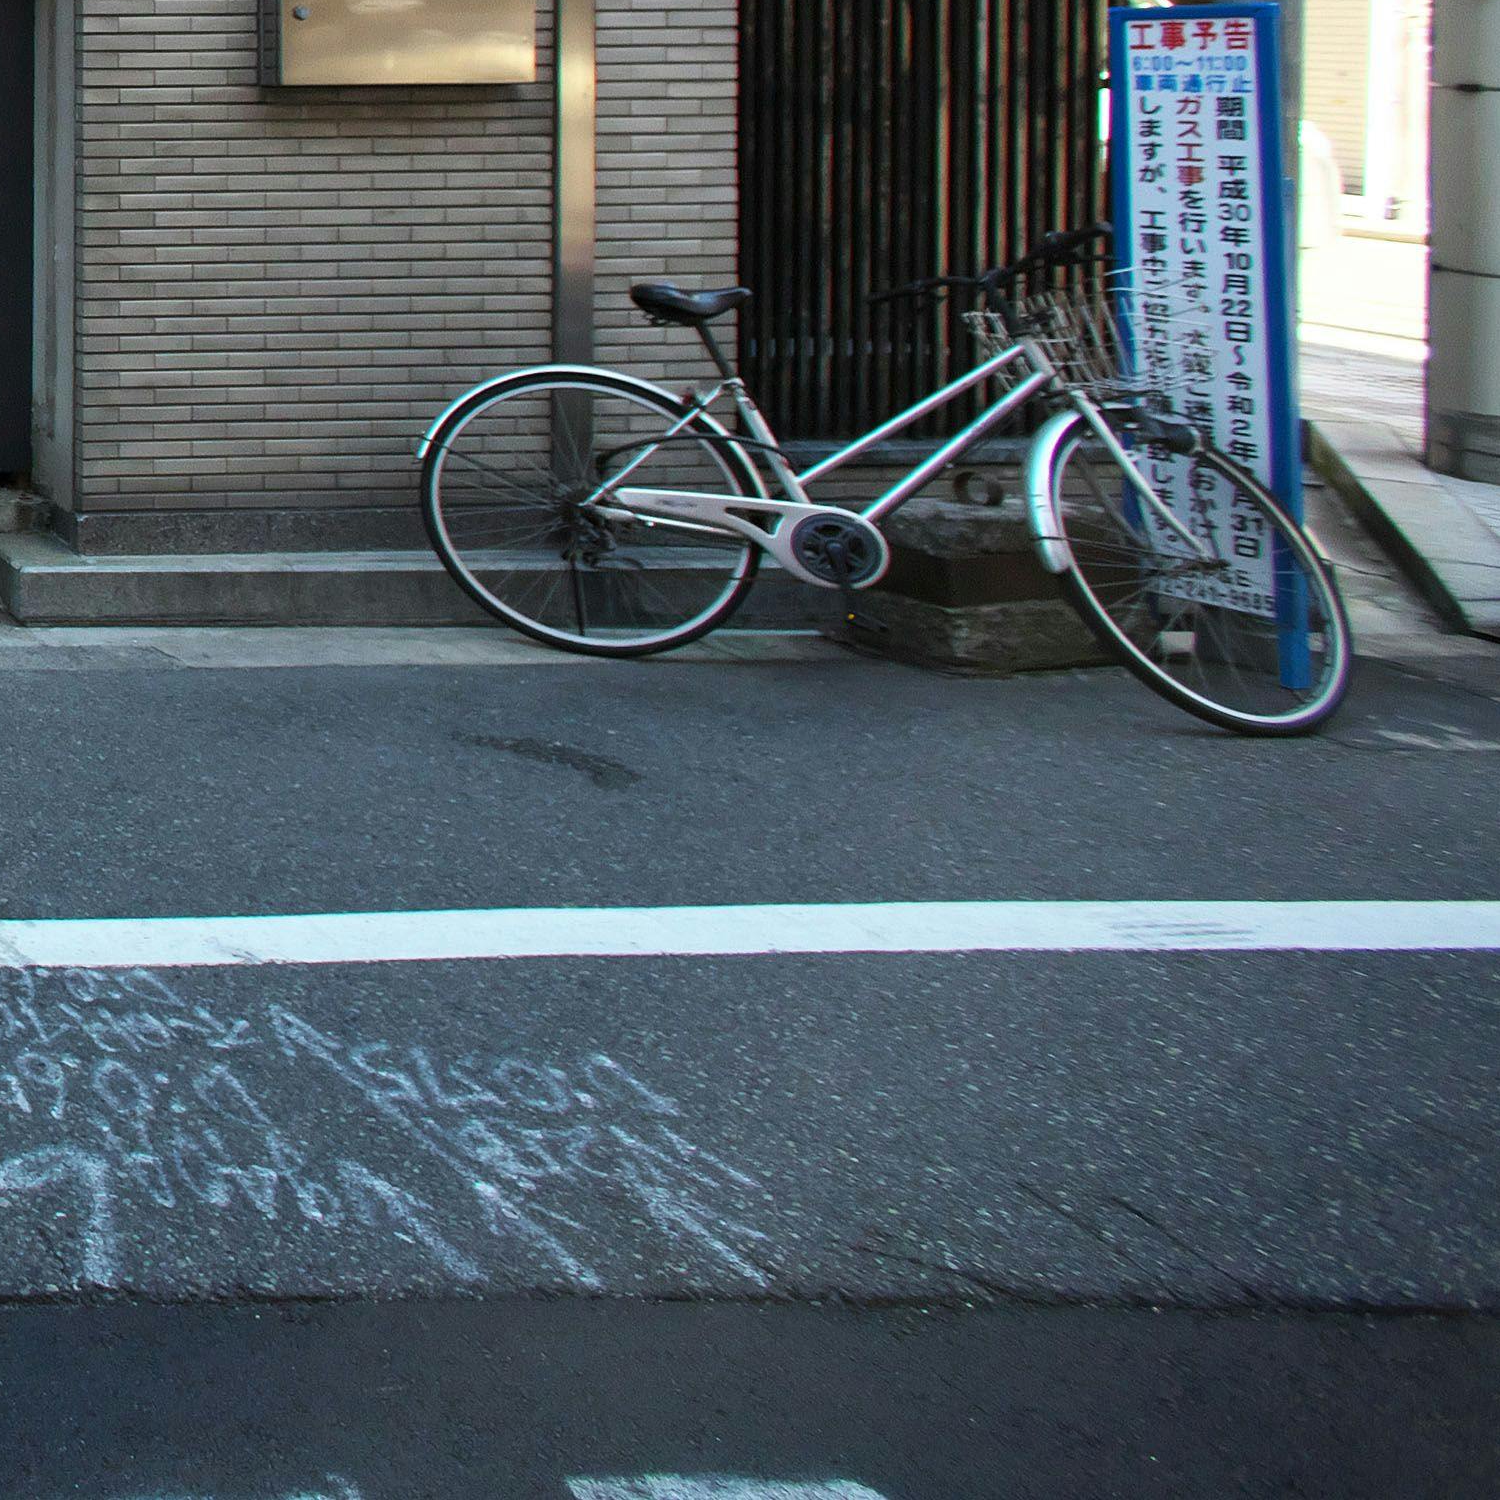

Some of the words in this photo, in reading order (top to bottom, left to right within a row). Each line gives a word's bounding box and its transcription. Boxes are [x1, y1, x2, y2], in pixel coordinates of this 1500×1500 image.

[1129, 19, 1253, 51] 工事予告
[1134, 73, 1253, 93] 車両通行止
[1215, 96, 1247, 141] 期間
